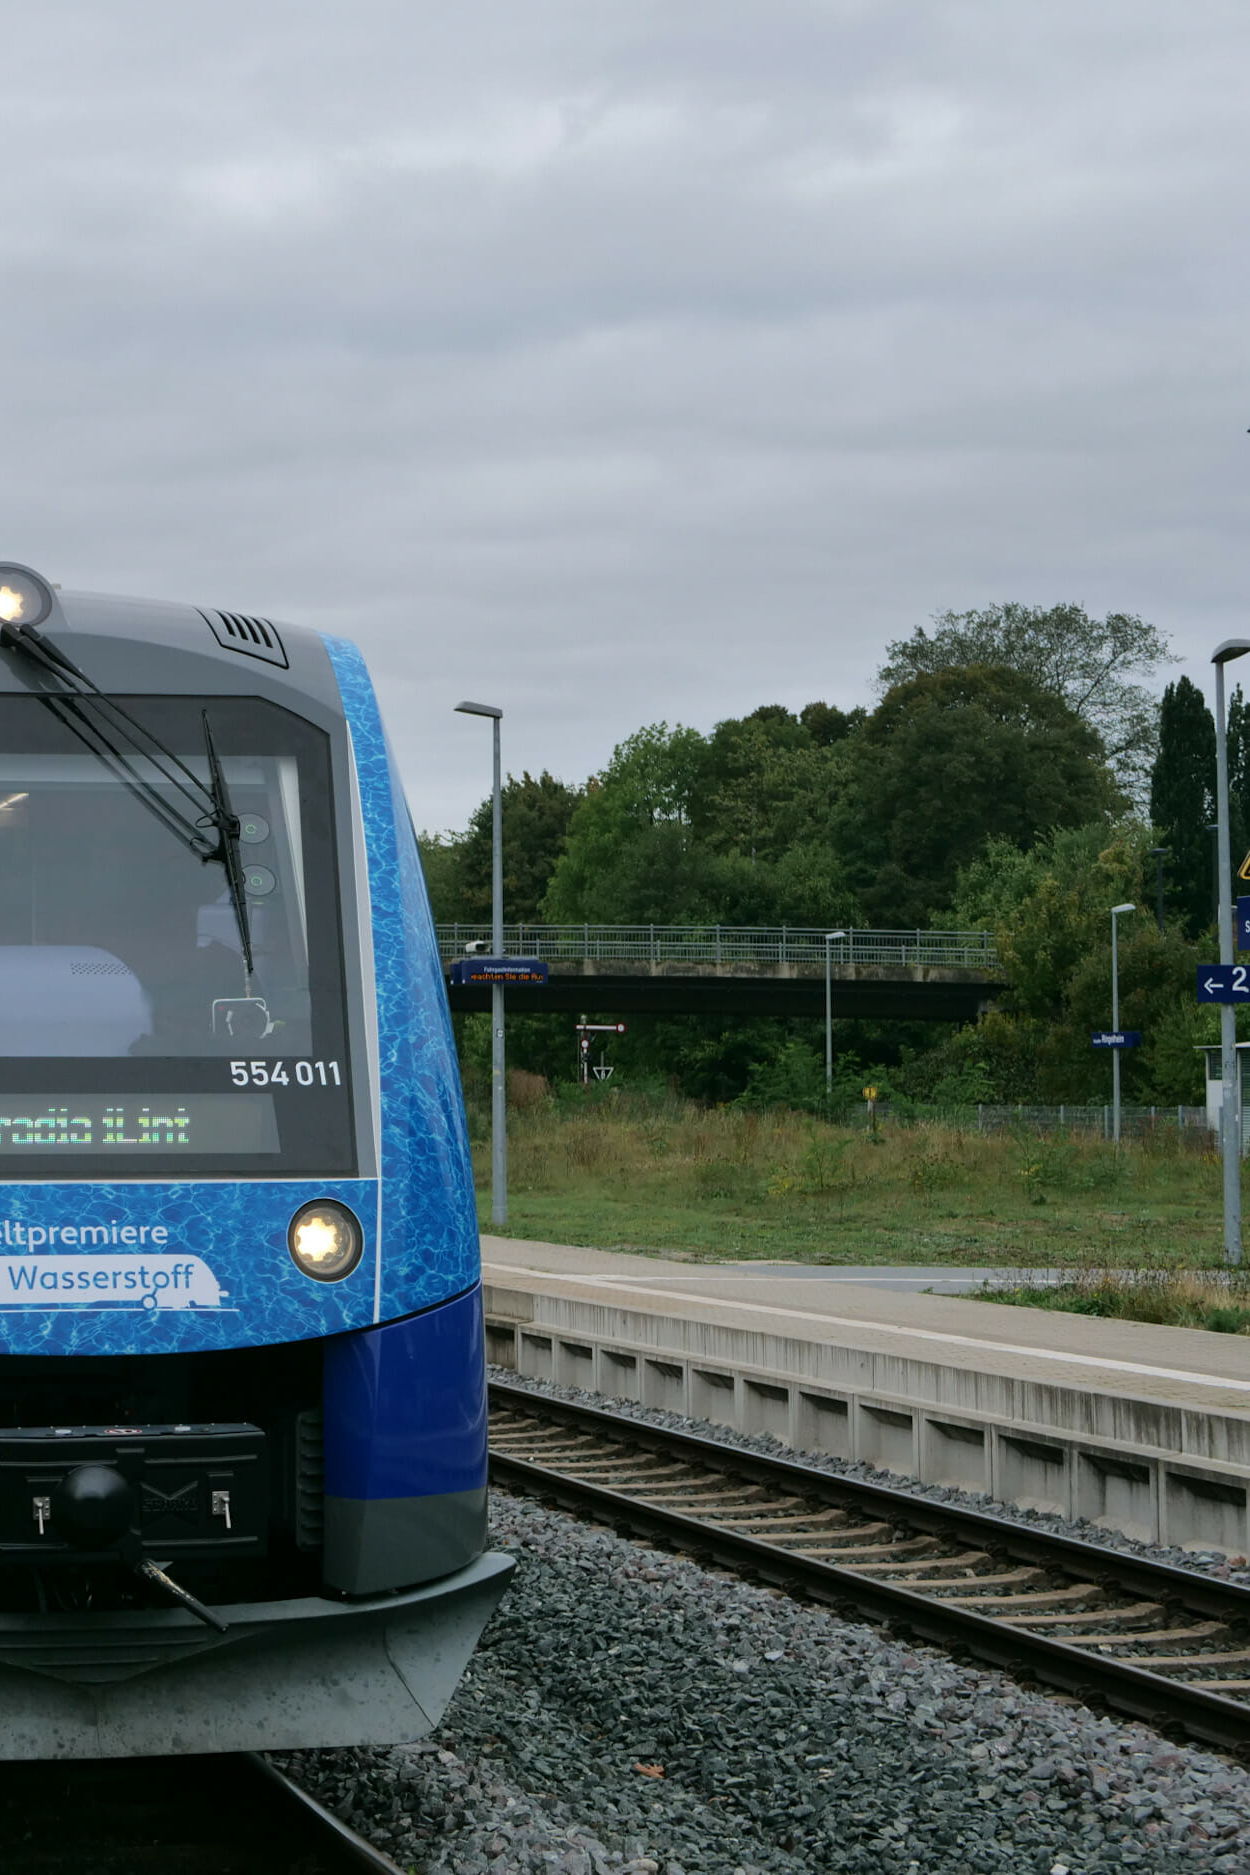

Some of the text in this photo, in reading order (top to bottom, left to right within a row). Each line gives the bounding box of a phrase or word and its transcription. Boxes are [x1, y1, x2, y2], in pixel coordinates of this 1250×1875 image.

[230, 1061, 342, 1087] 554 011
[102, 1108, 191, 1145] iLint
[8, 1263, 195, 1291] Wasserstoff
